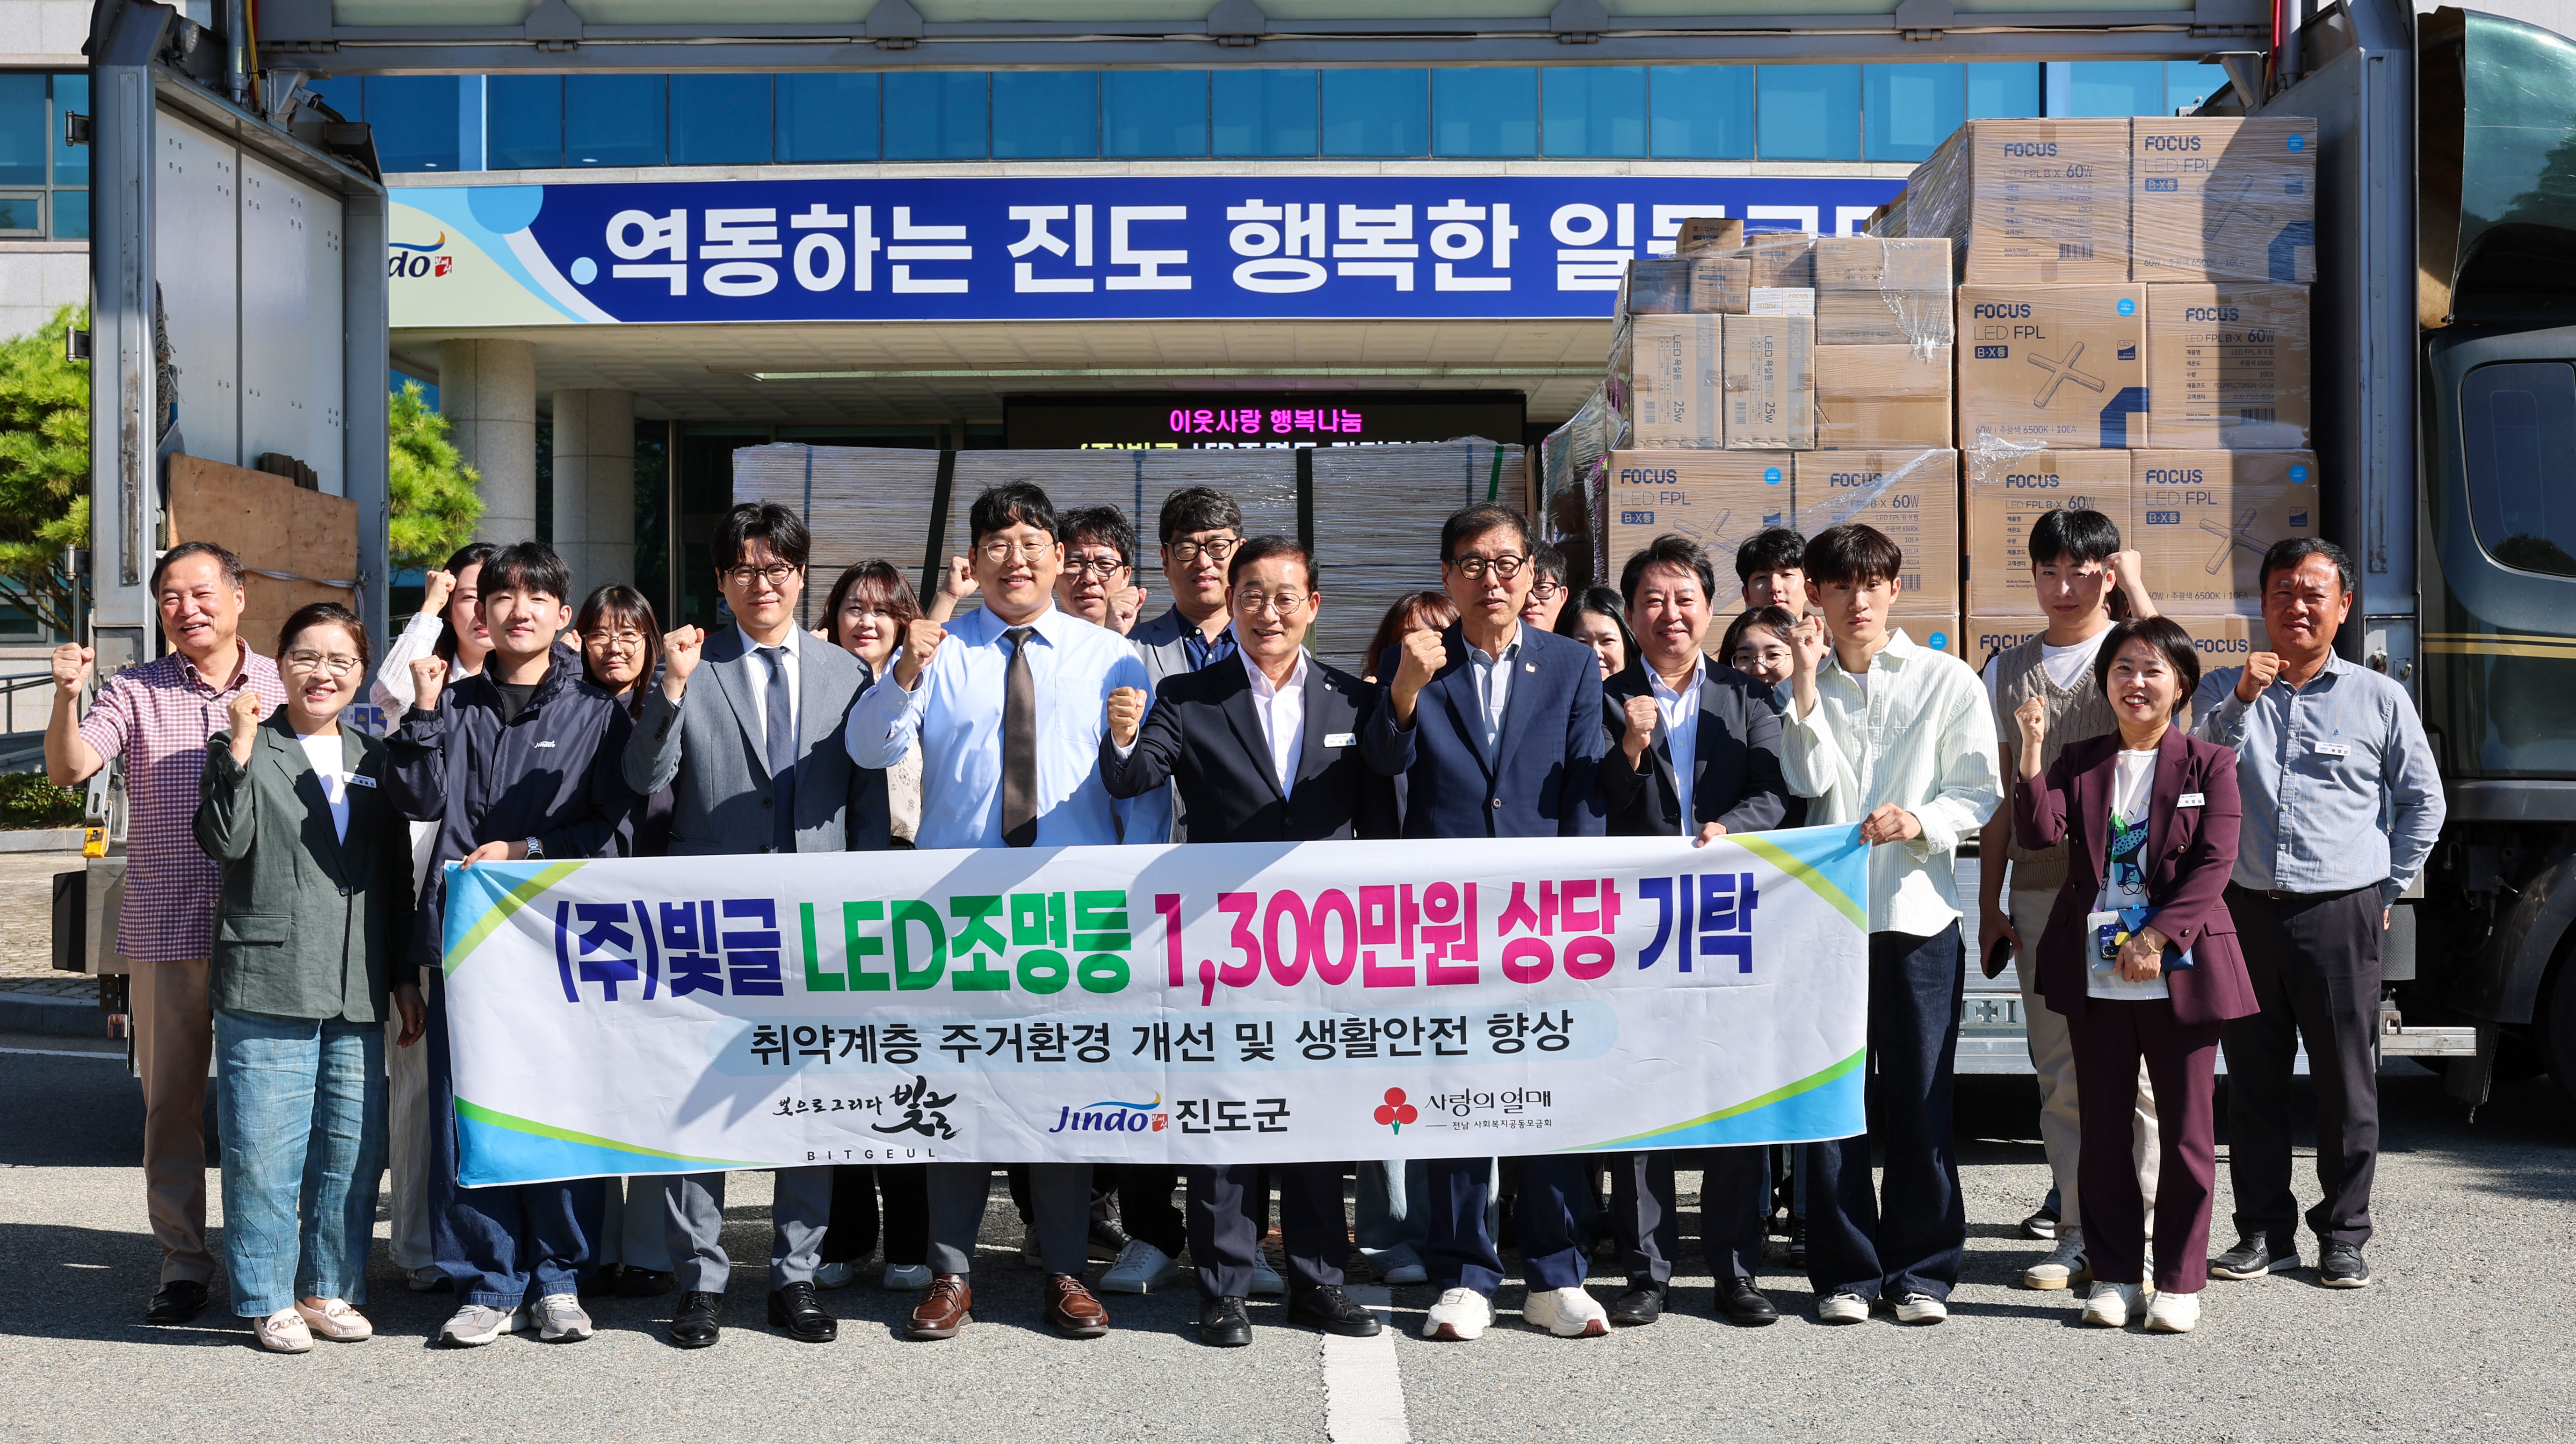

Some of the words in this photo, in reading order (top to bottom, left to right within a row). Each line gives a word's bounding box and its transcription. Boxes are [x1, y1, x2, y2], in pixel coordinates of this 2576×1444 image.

[2004, 143, 2057, 157] FOCUS
[2145, 136, 2201, 151] FOCUS
[2066, 165, 2092, 178] 60W
[2144, 159, 2178, 173] LED
[2184, 159, 2215, 172] FPL
[606, 204, 972, 296] 역동하는
[1007, 204, 1191, 293] 진도
[1227, 199, 1519, 293] 행복한
[2192, 258, 2217, 267] 6500K
[1975, 304, 2031, 318] FOCUS
[2185, 307, 2239, 321] FOCUS
[1975, 326, 2008, 340] LED
[2014, 326, 2045, 339] FPL
[2248, 329, 2274, 342] 60W
[1673, 359, 1682, 381] 욕실등
[1765, 360, 1773, 381] 욕실등
[1170, 409, 1262, 434] 이웃사랑
[1270, 409, 1363, 434] 행복나눔
[2057, 425, 2077, 433] 10EA
[1621, 469, 1677, 484] FOCUS
[1831, 473, 1882, 487] FOCUS
[2006, 474, 2060, 488] FOCUS
[2146, 469, 2202, 484] FOCUS
[1621, 491, 1654, 505] LED
[1660, 491, 1691, 505] FPL
[1893, 495, 1919, 508] 60W
[2068, 496, 2095, 509] 60W
[2146, 491, 2180, 505] LED
[2185, 491, 2217, 505] FPL
[2171, 592, 2192, 600] 주광색
[2195, 639, 2248, 653] FOCUS
[555, 898, 784, 1003] (주)빛글
[800, 890, 1131, 994] LED조명등
[1156, 881, 1479, 1006] 1,300만원
[1498, 878, 1621, 982] 상당
[1638, 873, 1759, 974] 기탁
[751, 1024, 922, 1066] 취약계층
[940, 1023, 1110, 1063] 주거환경
[1132, 1022, 1215, 1062] 개선
[1236, 1021, 1275, 1062] 및
[1295, 1016, 1468, 1060] 생활안전
[1487, 1010, 1573, 1054] 향상
[773, 1097, 826, 1116] 빛으로
[831, 1096, 883, 1116] 그리다
[1424, 1088, 1494, 1117] 사랑의
[1500, 1087, 1551, 1114] 열매
[1049, 1106, 1148, 1132] Jindo
[1176, 1098, 1290, 1134] 진도군
[1452, 1121, 1469, 1130] 전남
[1474, 1119, 1552, 1129] 사회복지공동모금회
[807, 1148, 935, 1161] BITGEUL
